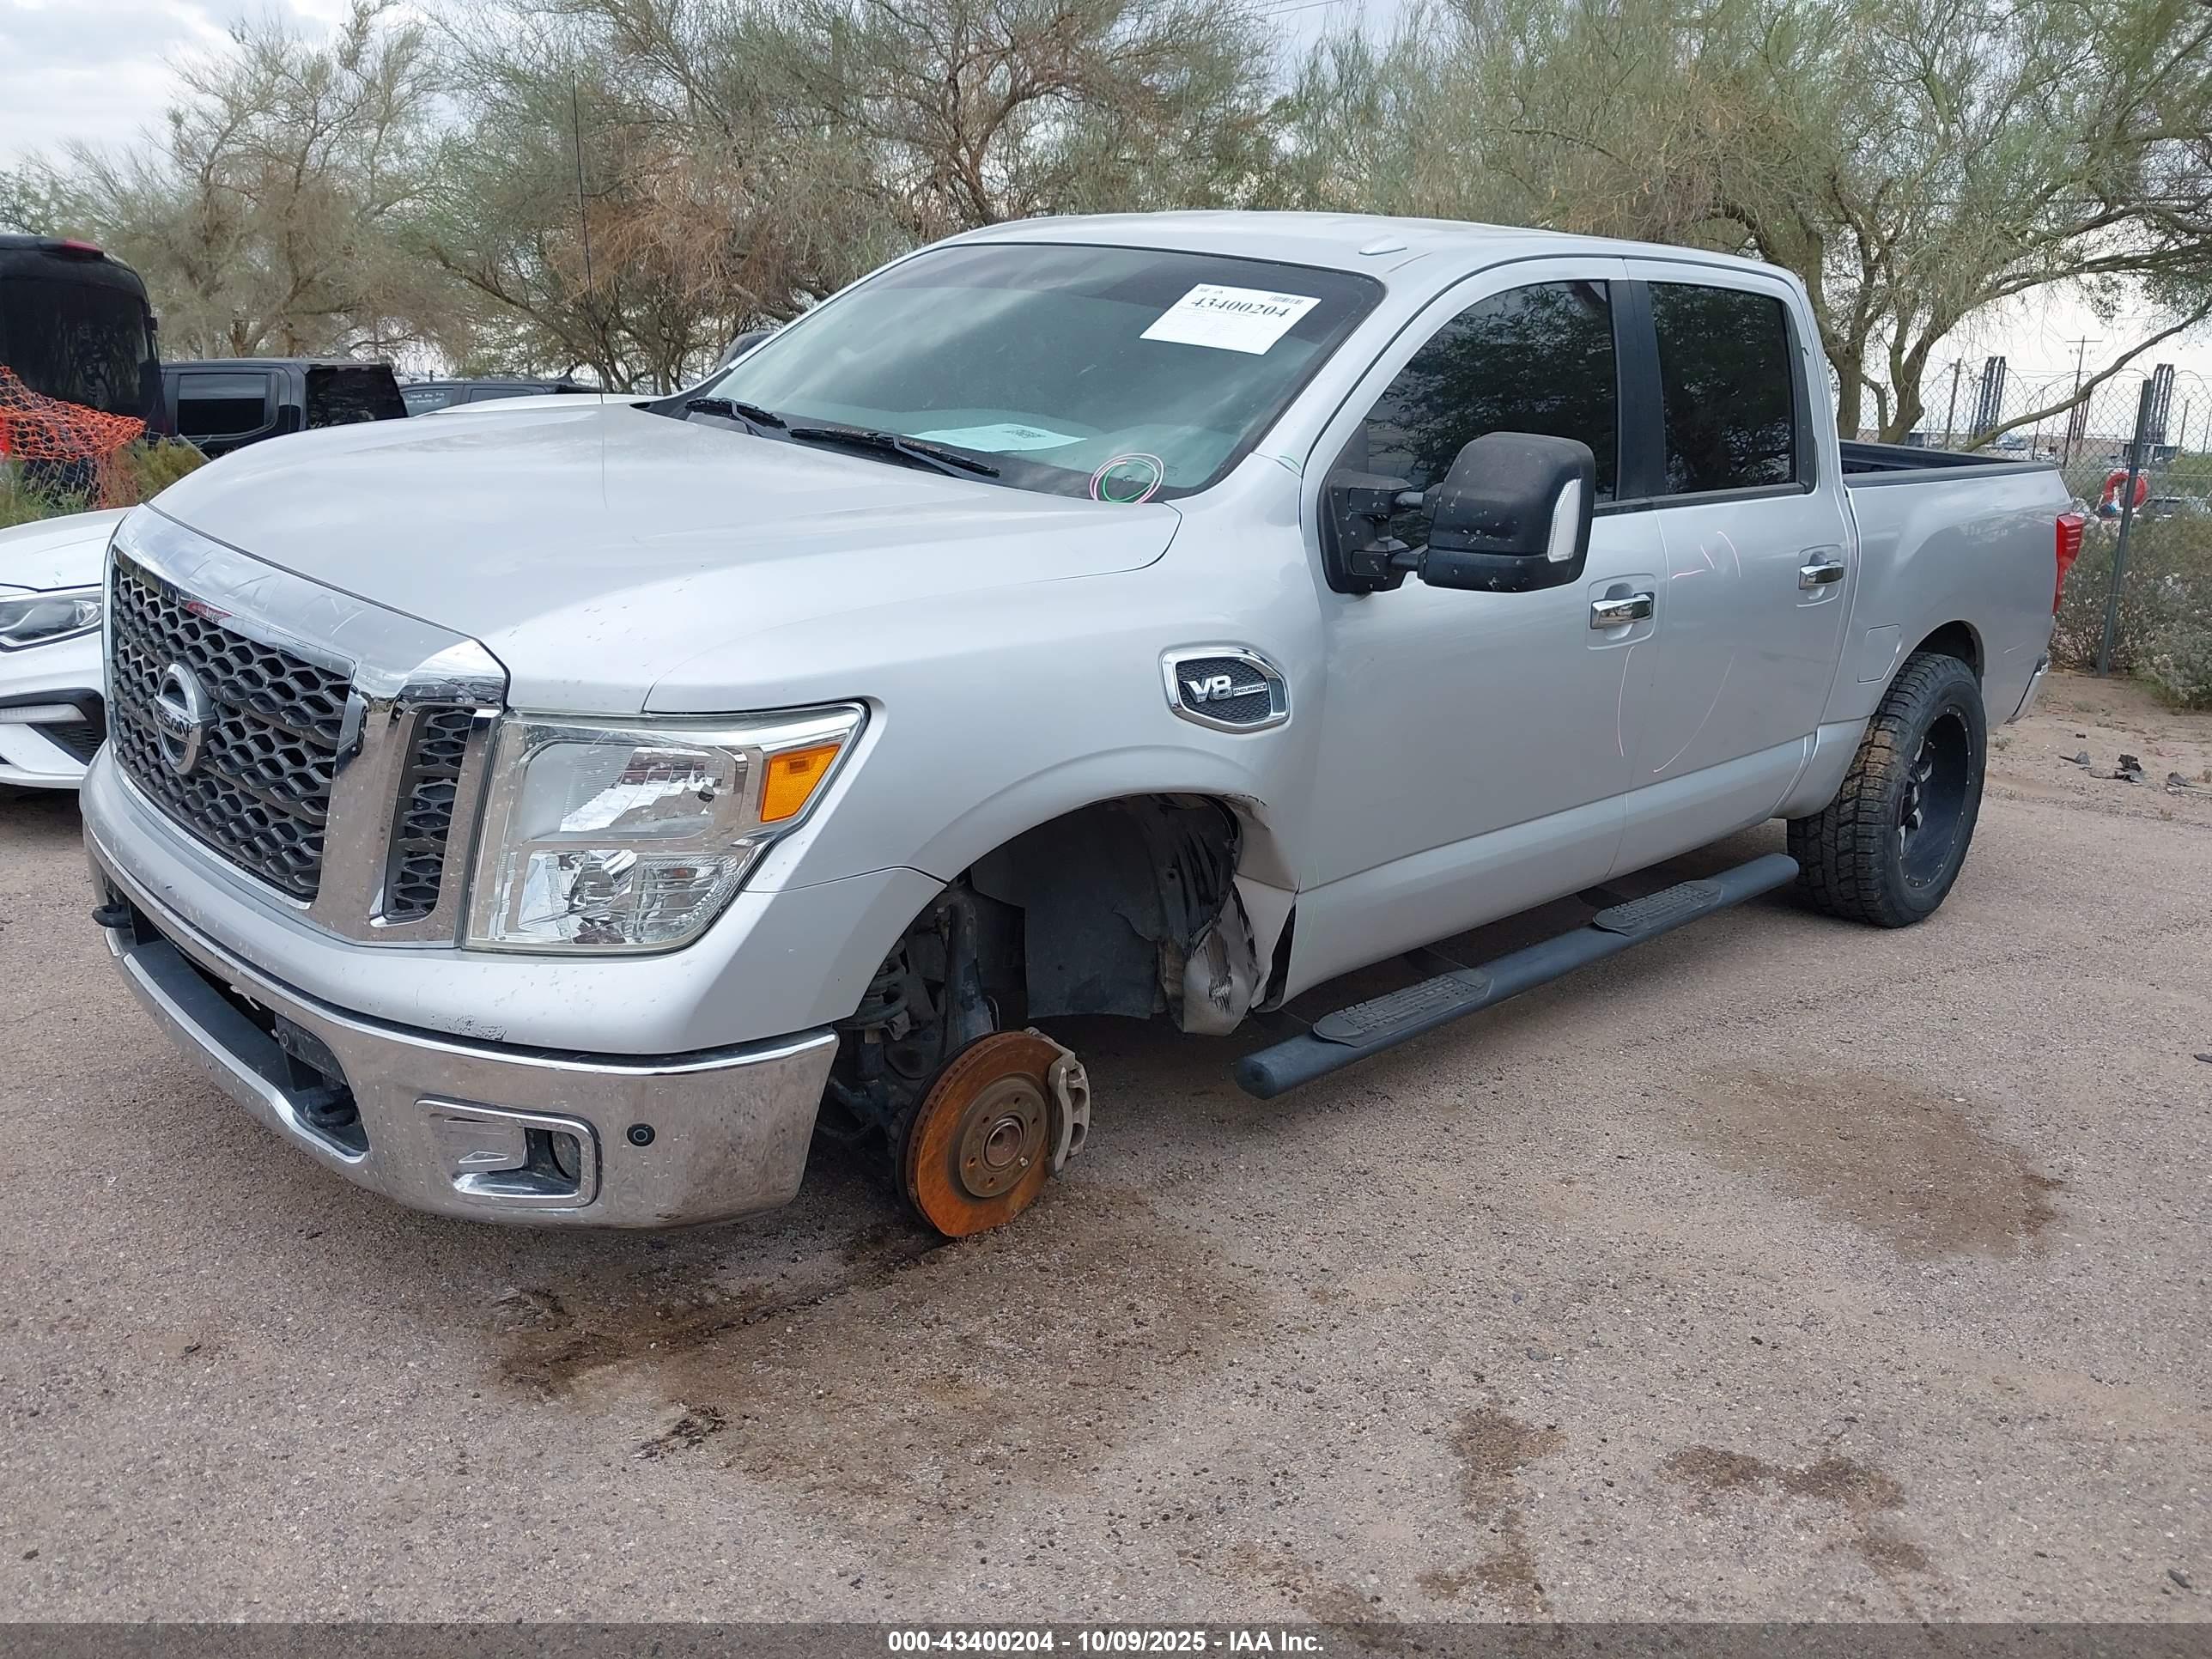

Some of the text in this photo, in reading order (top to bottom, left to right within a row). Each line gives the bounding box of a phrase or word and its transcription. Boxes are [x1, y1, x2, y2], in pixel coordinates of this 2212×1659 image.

[1191, 297, 1291, 317] 43400204
[1180, 675, 1232, 703] V8
[154, 702, 191, 738] SSAN
